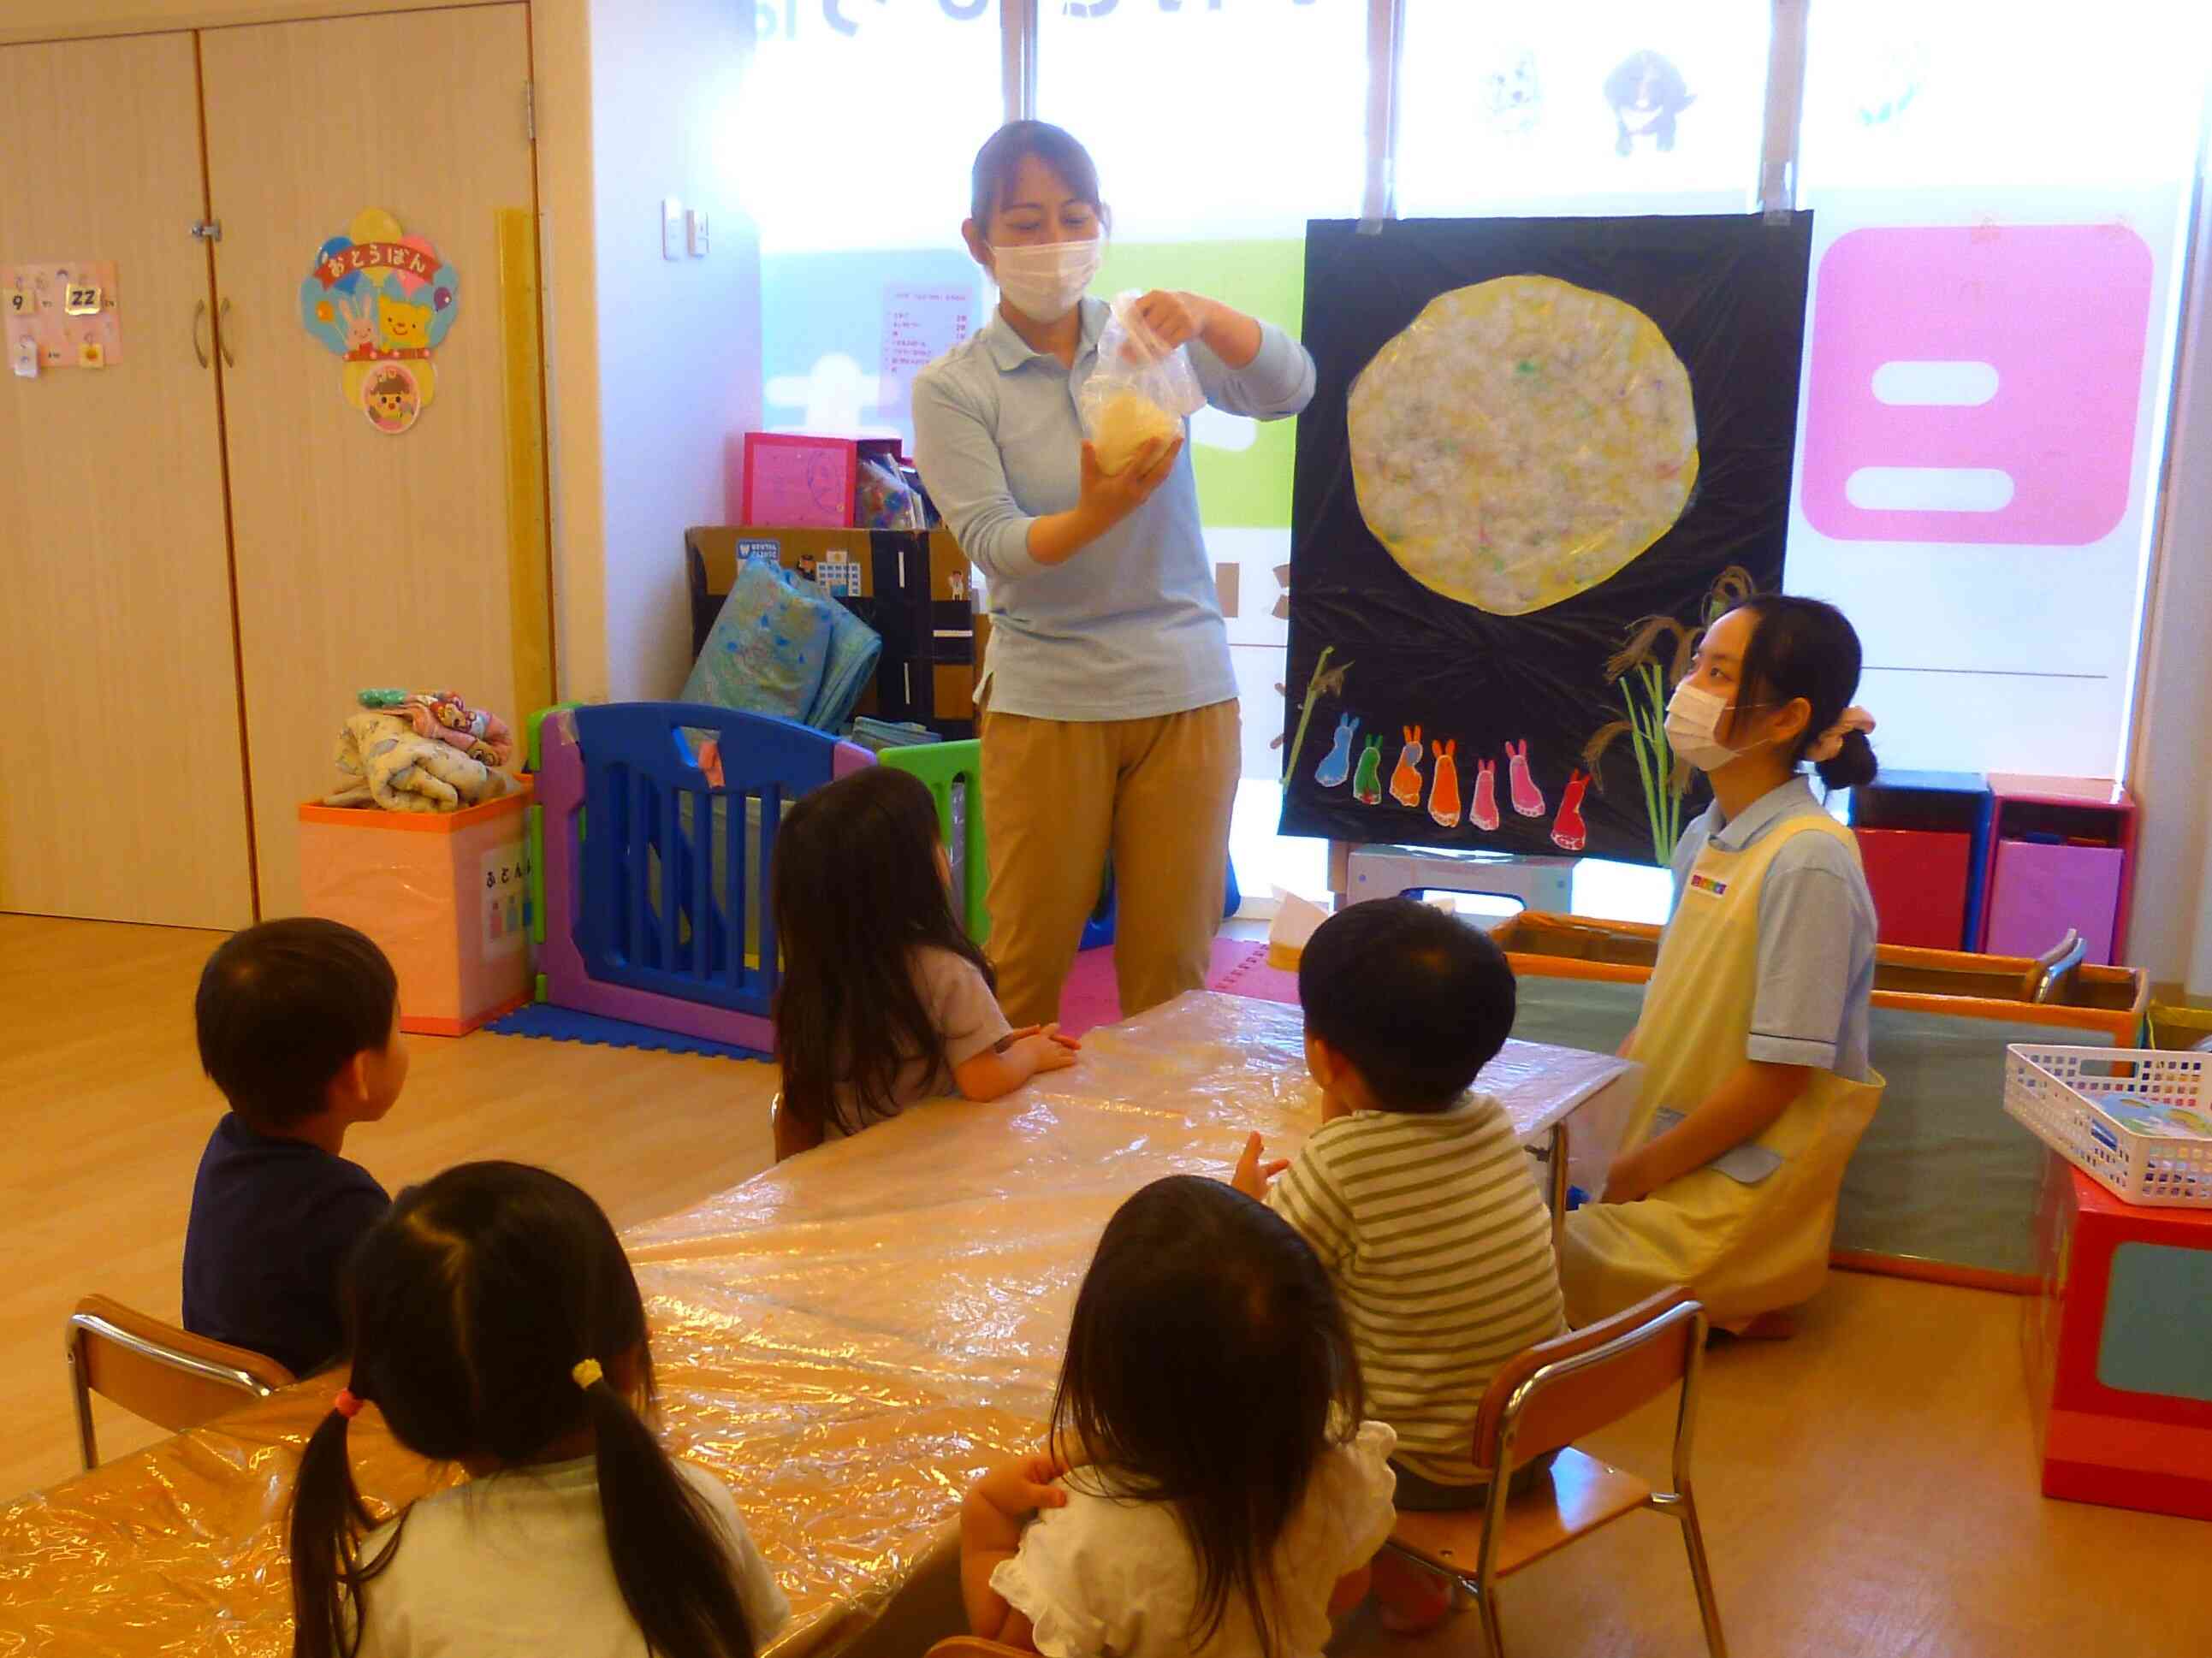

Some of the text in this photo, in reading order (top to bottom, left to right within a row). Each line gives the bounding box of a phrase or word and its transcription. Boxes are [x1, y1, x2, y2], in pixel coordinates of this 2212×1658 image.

[328, 244, 426, 278] おとうばん
[13, 294, 23, 310] 9
[71, 290, 96, 305] 22
